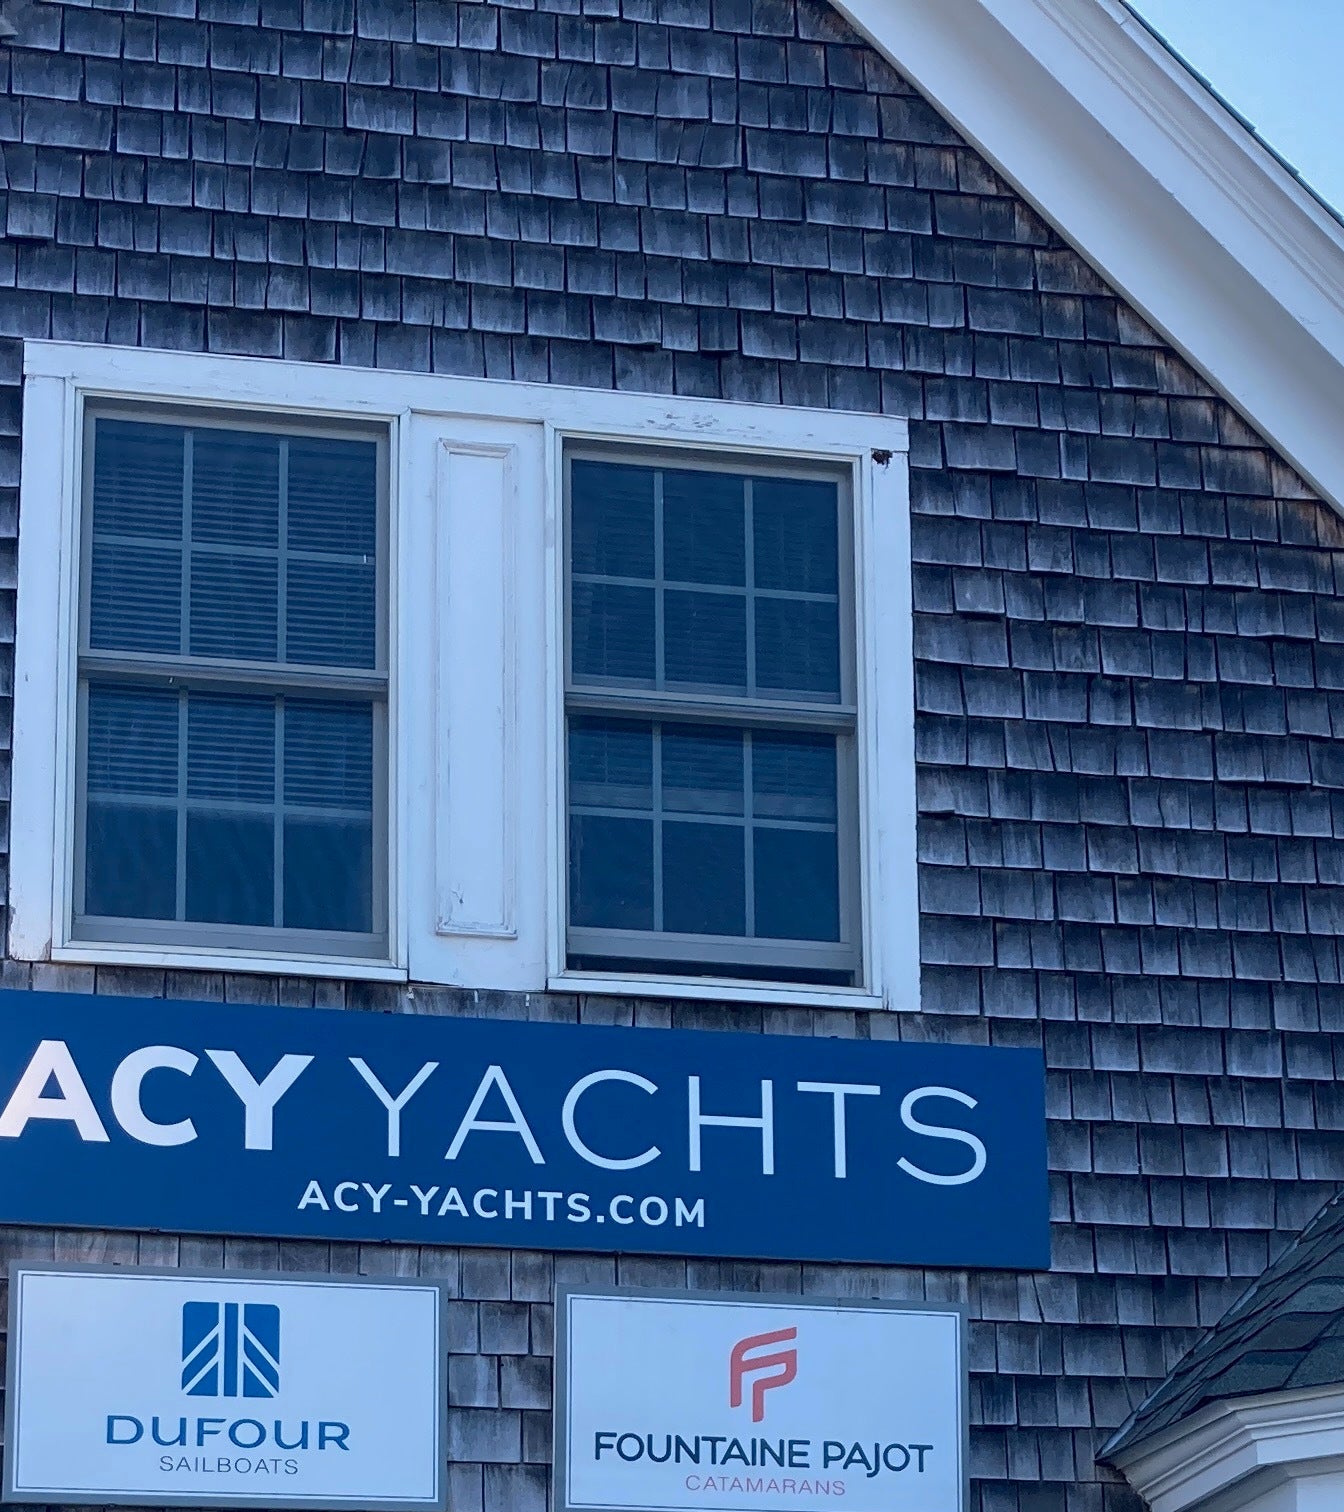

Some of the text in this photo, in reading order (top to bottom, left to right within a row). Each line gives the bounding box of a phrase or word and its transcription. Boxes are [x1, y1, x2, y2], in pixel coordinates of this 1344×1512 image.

[348, 1056, 987, 1186] YACHTS
[297, 1180, 705, 1228] ACY-YACHTS.COM
[106, 1414, 350, 1451] DUFOUR
[159, 1455, 298, 1475] SAILBOATS
[594, 1431, 934, 1479] FOUNTAINE PAJOT
[685, 1474, 846, 1496] CATAMARANS
